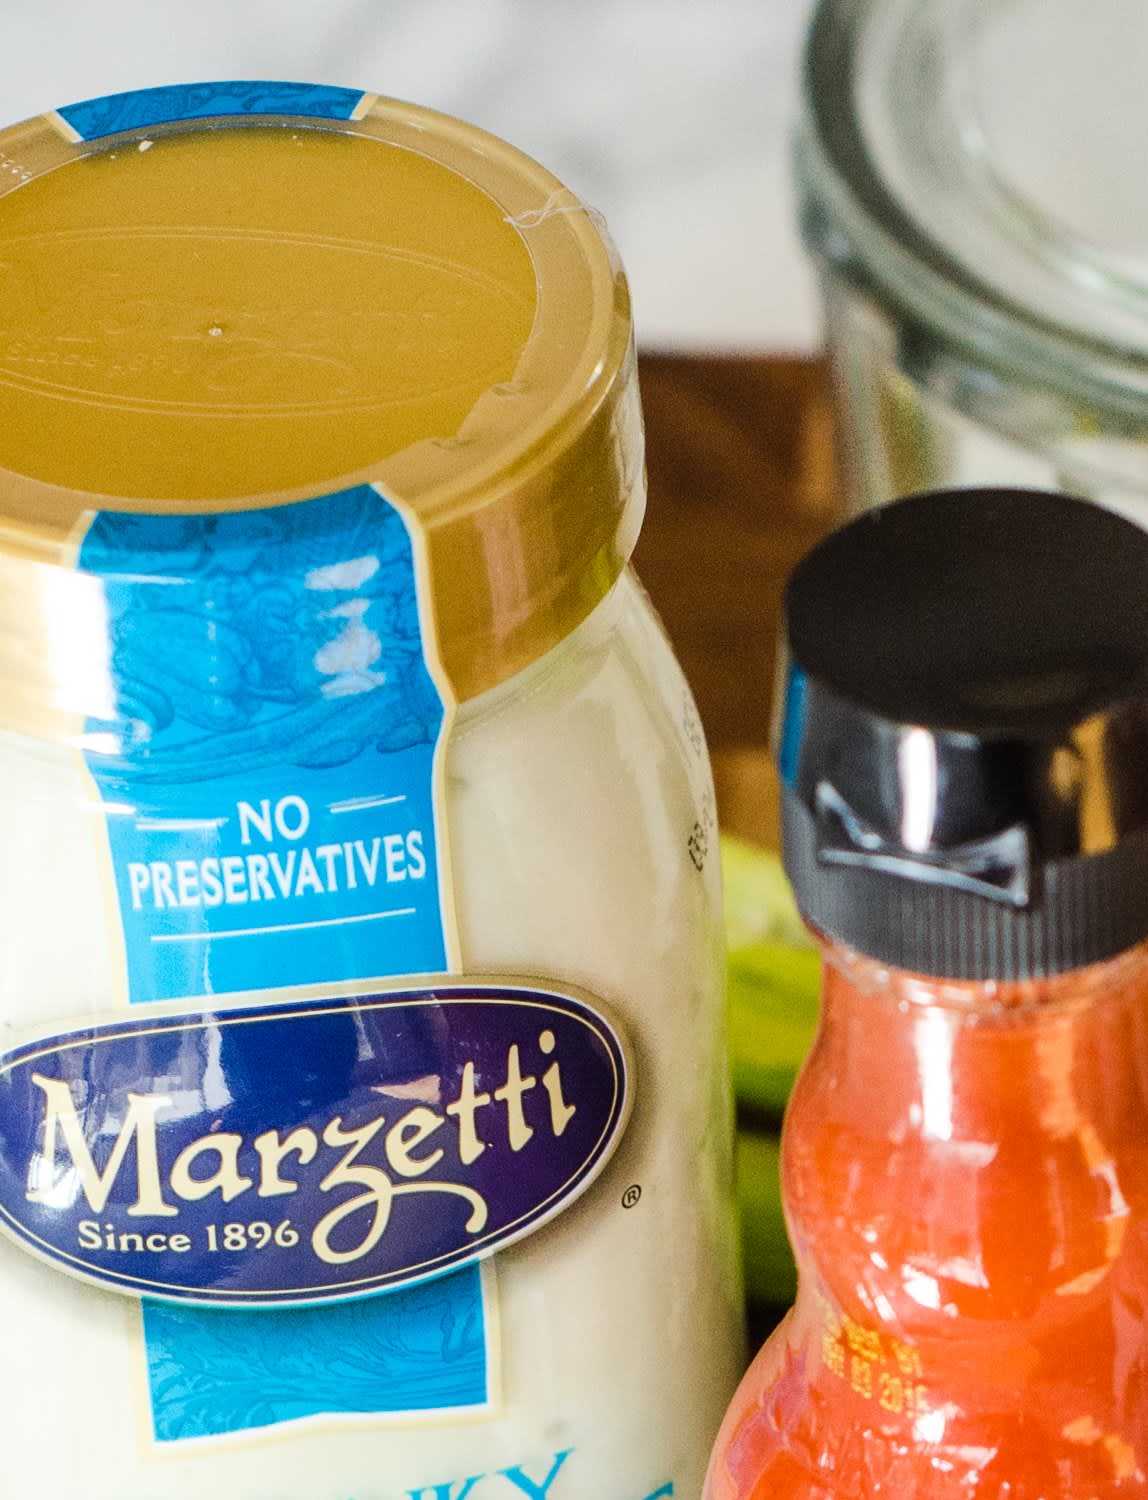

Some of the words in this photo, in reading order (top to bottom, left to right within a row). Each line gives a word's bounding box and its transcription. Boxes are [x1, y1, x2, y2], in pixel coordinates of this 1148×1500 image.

[237, 795, 311, 848] NO
[128, 829, 427, 911] PRESERVATIVES
[27, 1029, 577, 1264] Marzetti
[78, 1220, 192, 1254] Since
[206, 1221, 299, 1253] 1896
